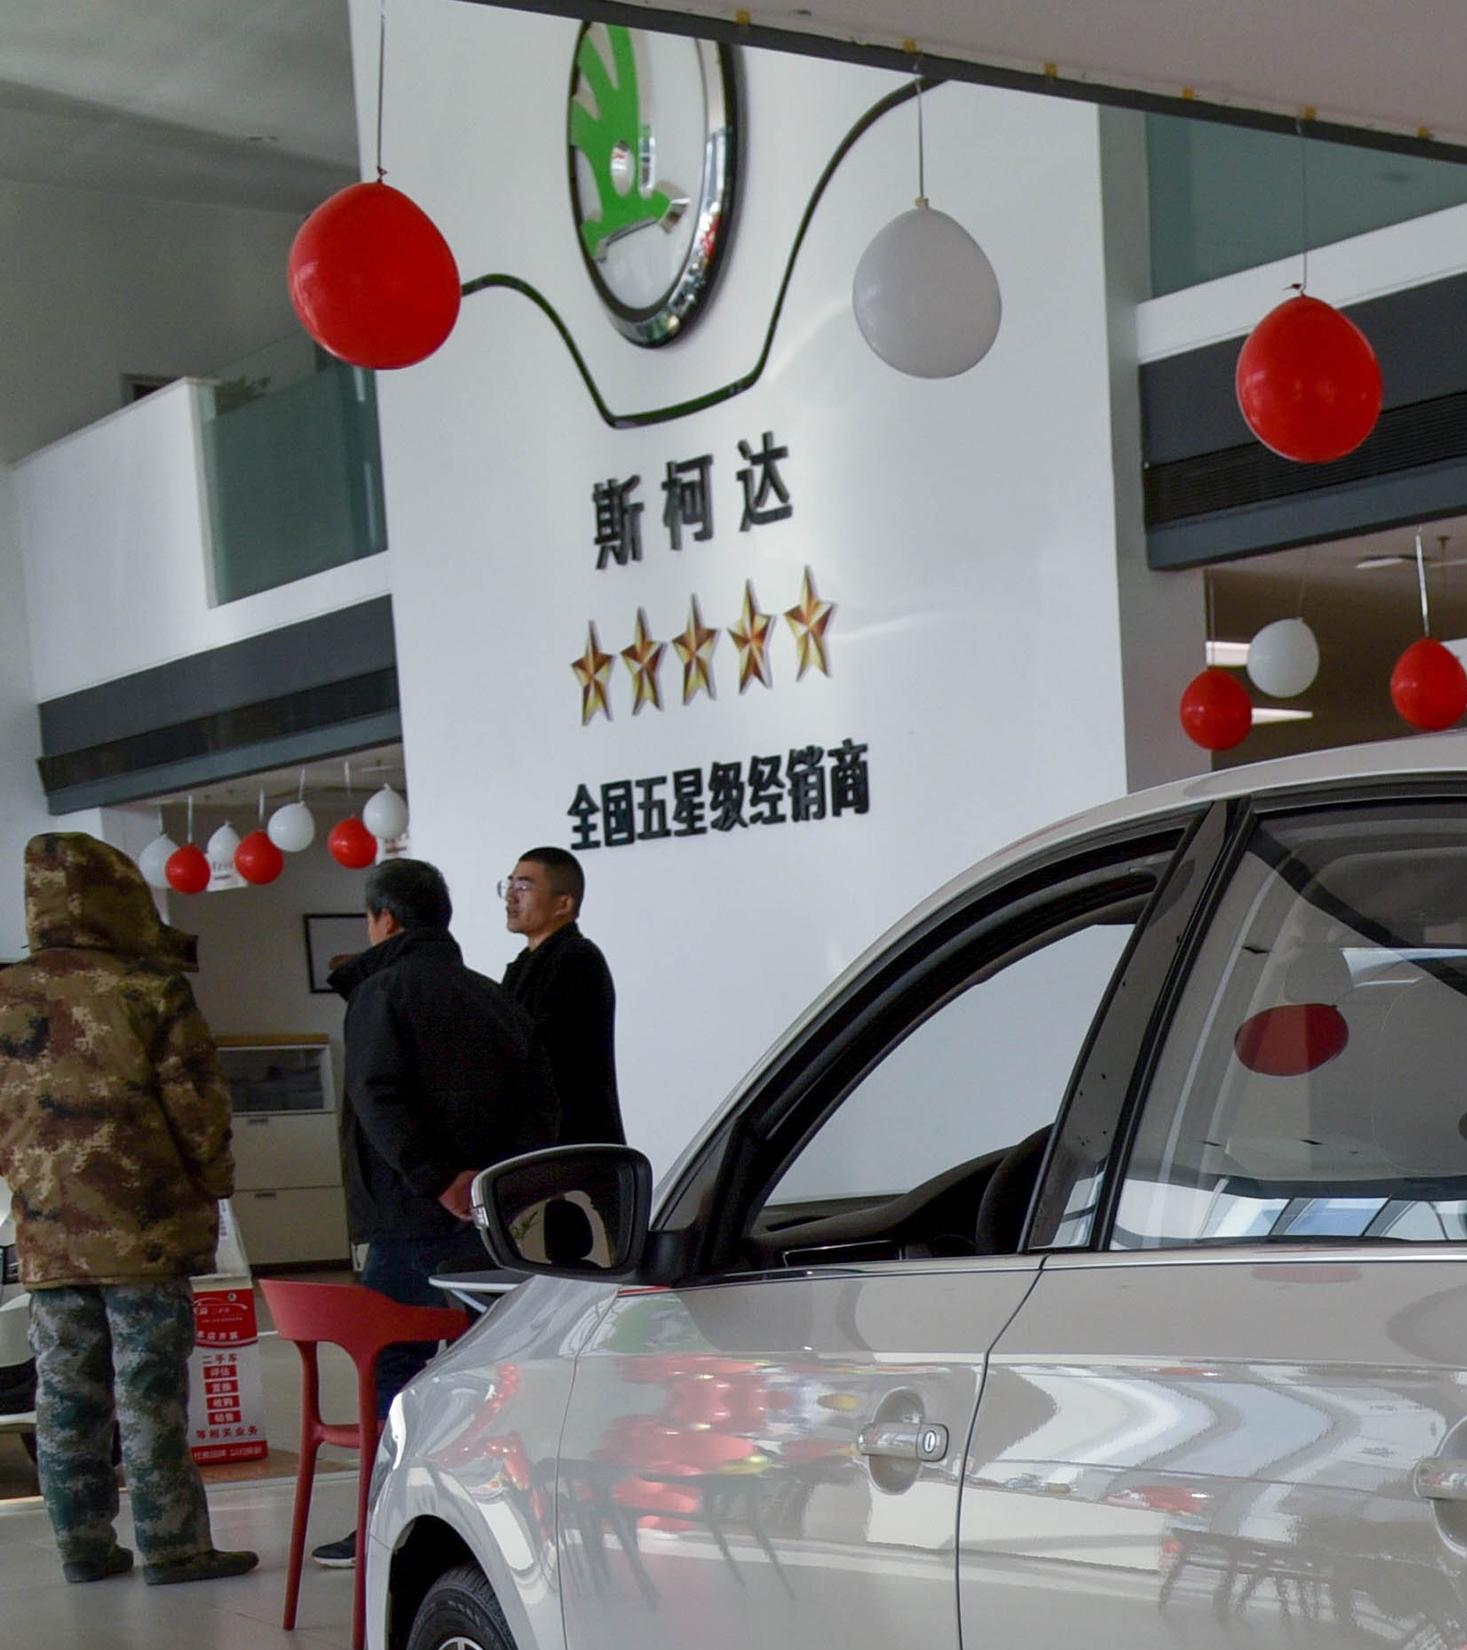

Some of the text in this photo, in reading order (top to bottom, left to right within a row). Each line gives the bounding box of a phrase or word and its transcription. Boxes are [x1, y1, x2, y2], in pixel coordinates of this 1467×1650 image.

[592, 430, 794, 571] 斯柯达
[566, 738, 871, 851] 全国五星级经销商
[201, 1353, 238, 1365] 二手车
[196, 1425, 258, 1440] 等相关业务
